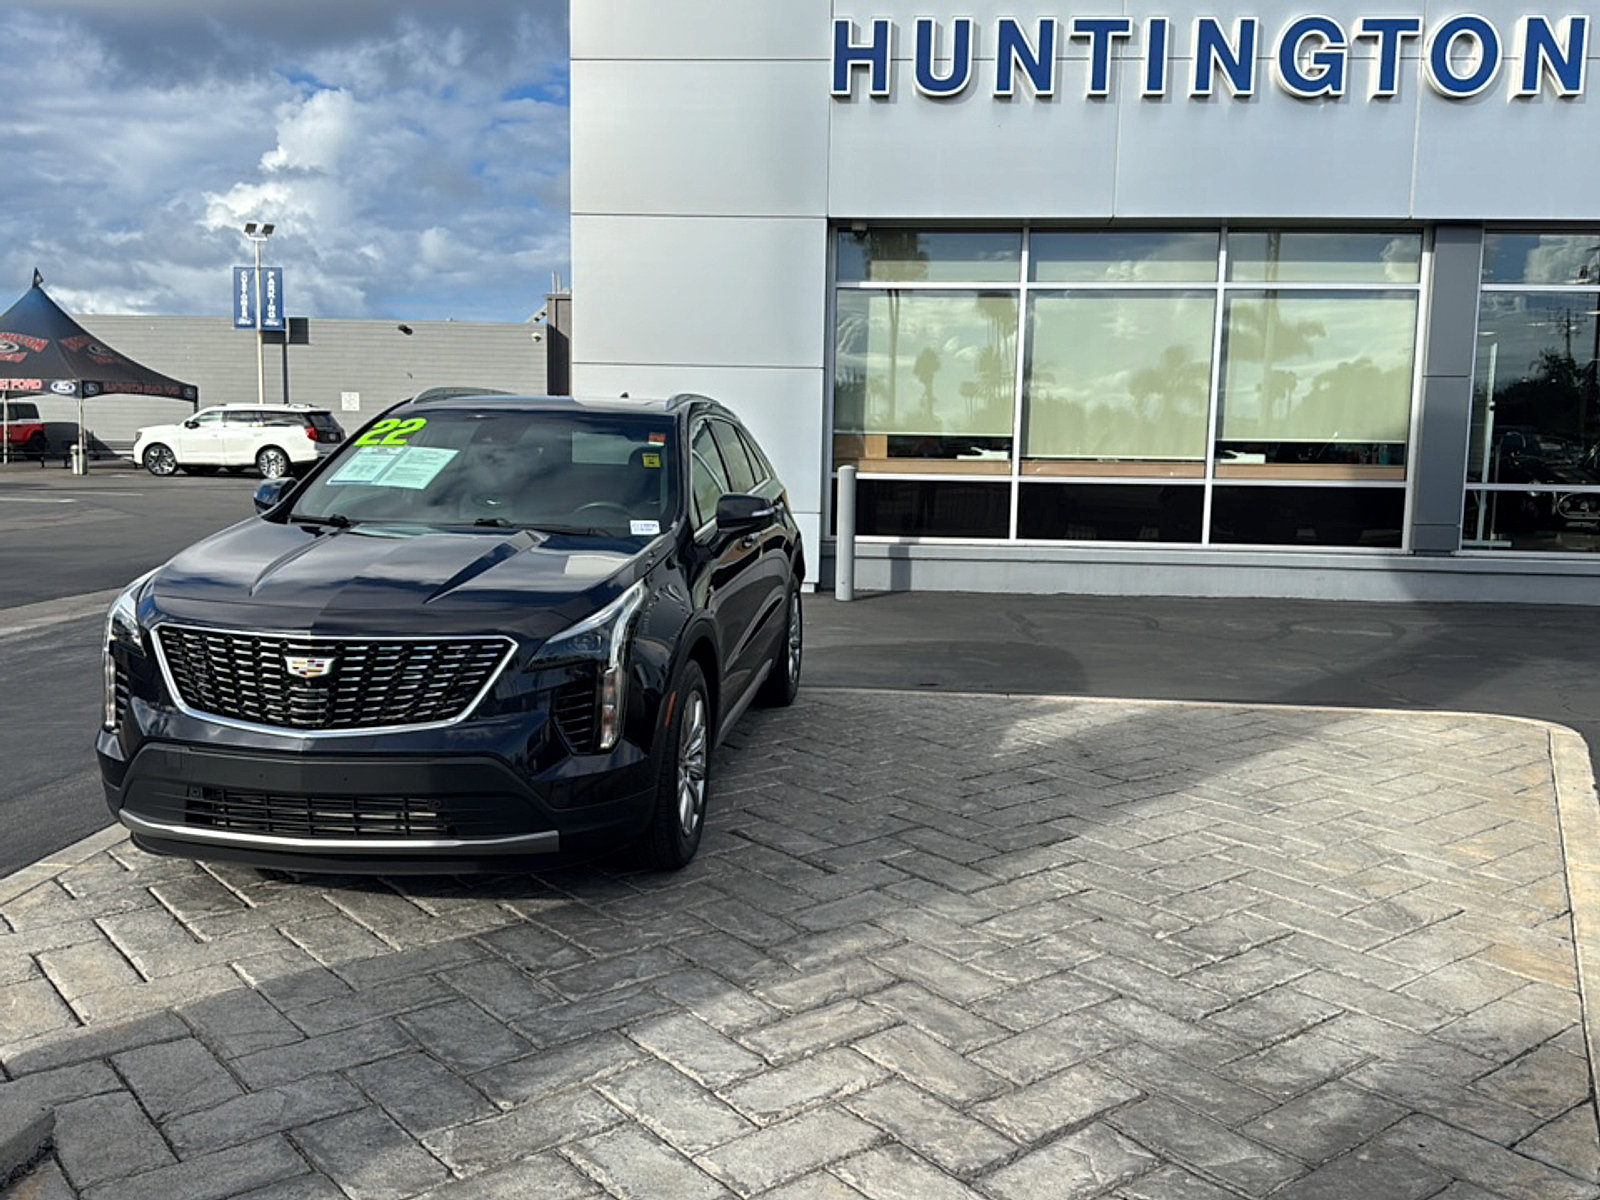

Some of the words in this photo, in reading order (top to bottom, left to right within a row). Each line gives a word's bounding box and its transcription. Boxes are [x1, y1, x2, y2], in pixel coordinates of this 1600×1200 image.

[830, 13, 1589, 98] HUNTINGTON
[267, 271, 275, 318] PARKING
[353, 418, 428, 448] 22
